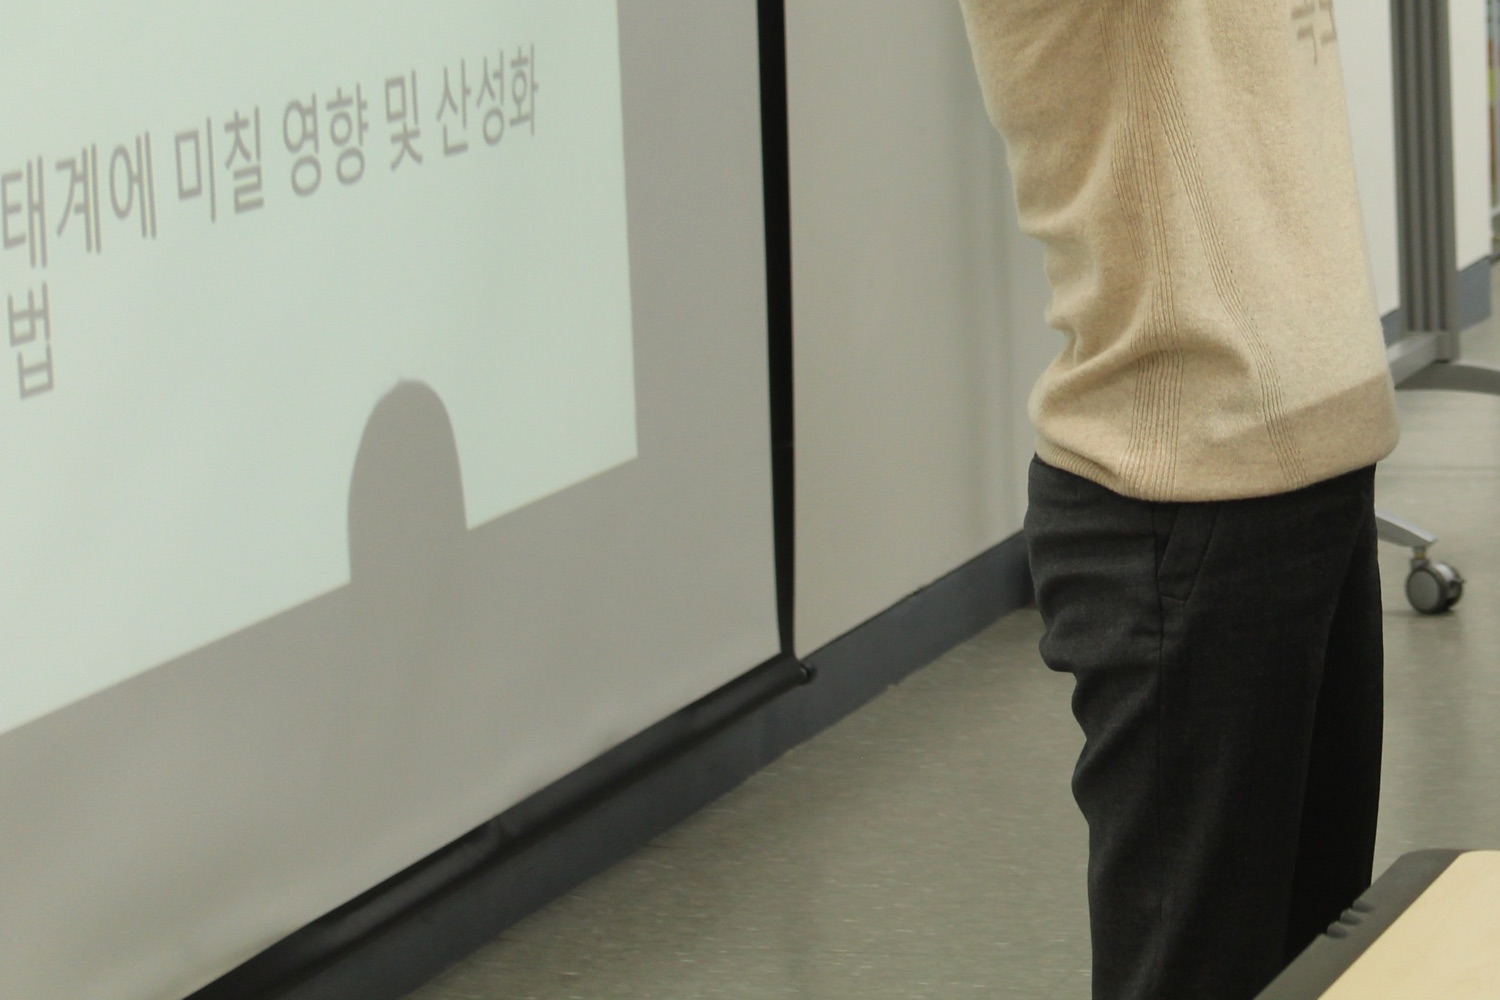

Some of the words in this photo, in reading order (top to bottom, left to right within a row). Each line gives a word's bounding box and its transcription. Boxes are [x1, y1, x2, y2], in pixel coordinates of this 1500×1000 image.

[1, 132, 157, 268] 태계에
[175, 106, 264, 223] 미칠
[283, 83, 368, 197] 영향
[385, 70, 423, 171] 및
[437, 43, 539, 157] 산성화
[8, 282, 54, 400] 법
